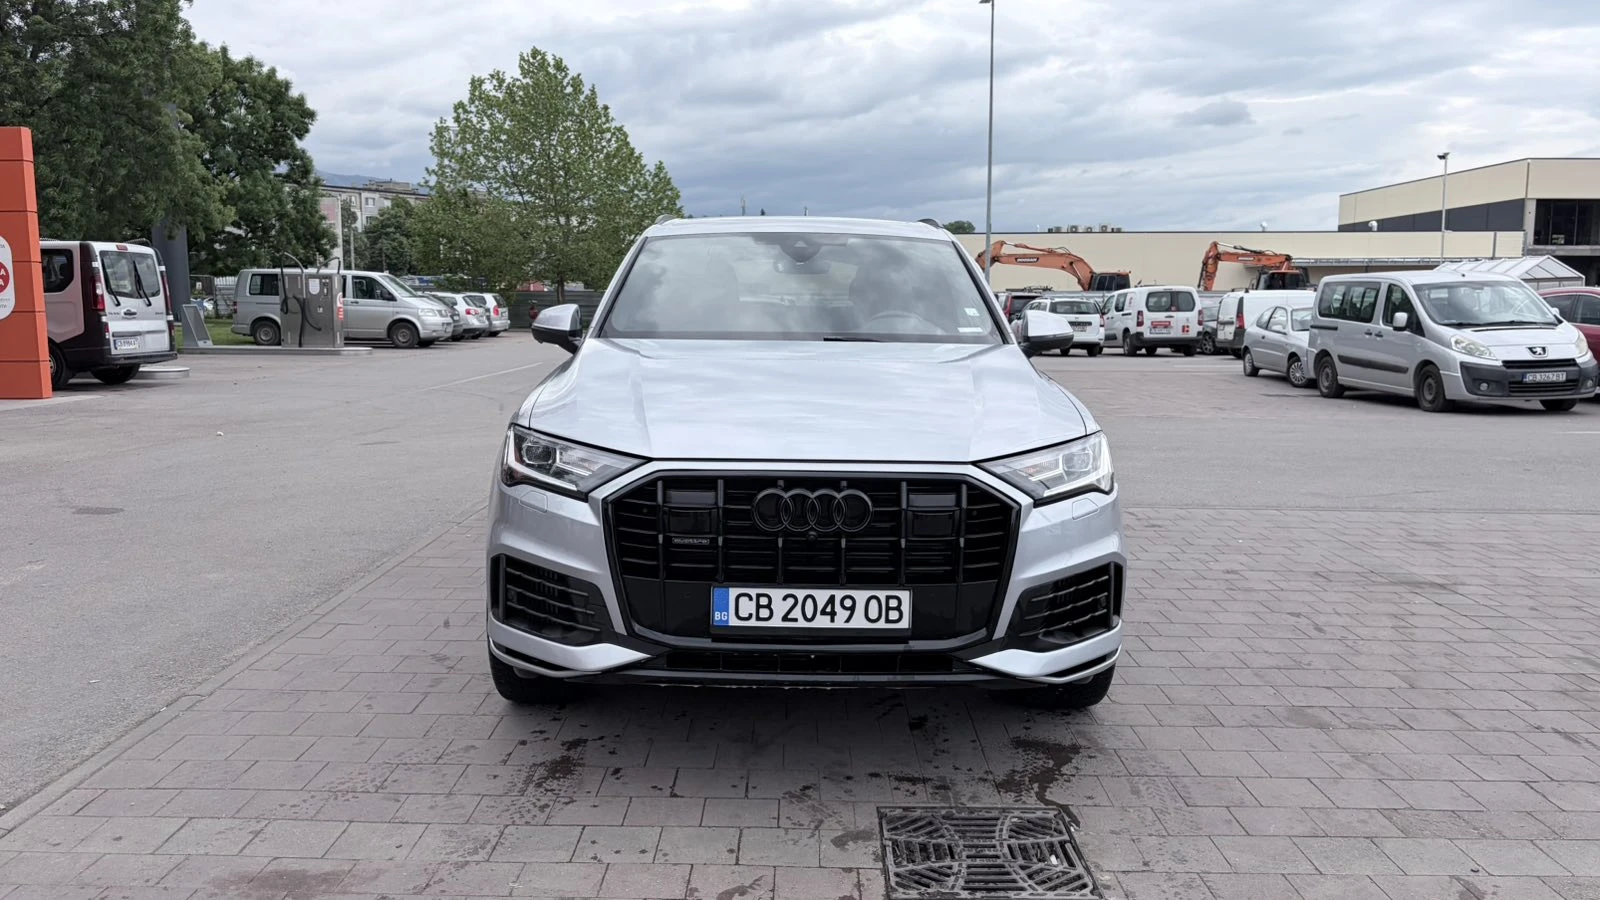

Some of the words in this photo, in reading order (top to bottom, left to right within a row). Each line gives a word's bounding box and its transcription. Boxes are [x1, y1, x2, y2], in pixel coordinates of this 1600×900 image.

[714, 611, 728, 621] BG
[734, 592, 774, 622] CB
[781, 593, 857, 623] 2049
